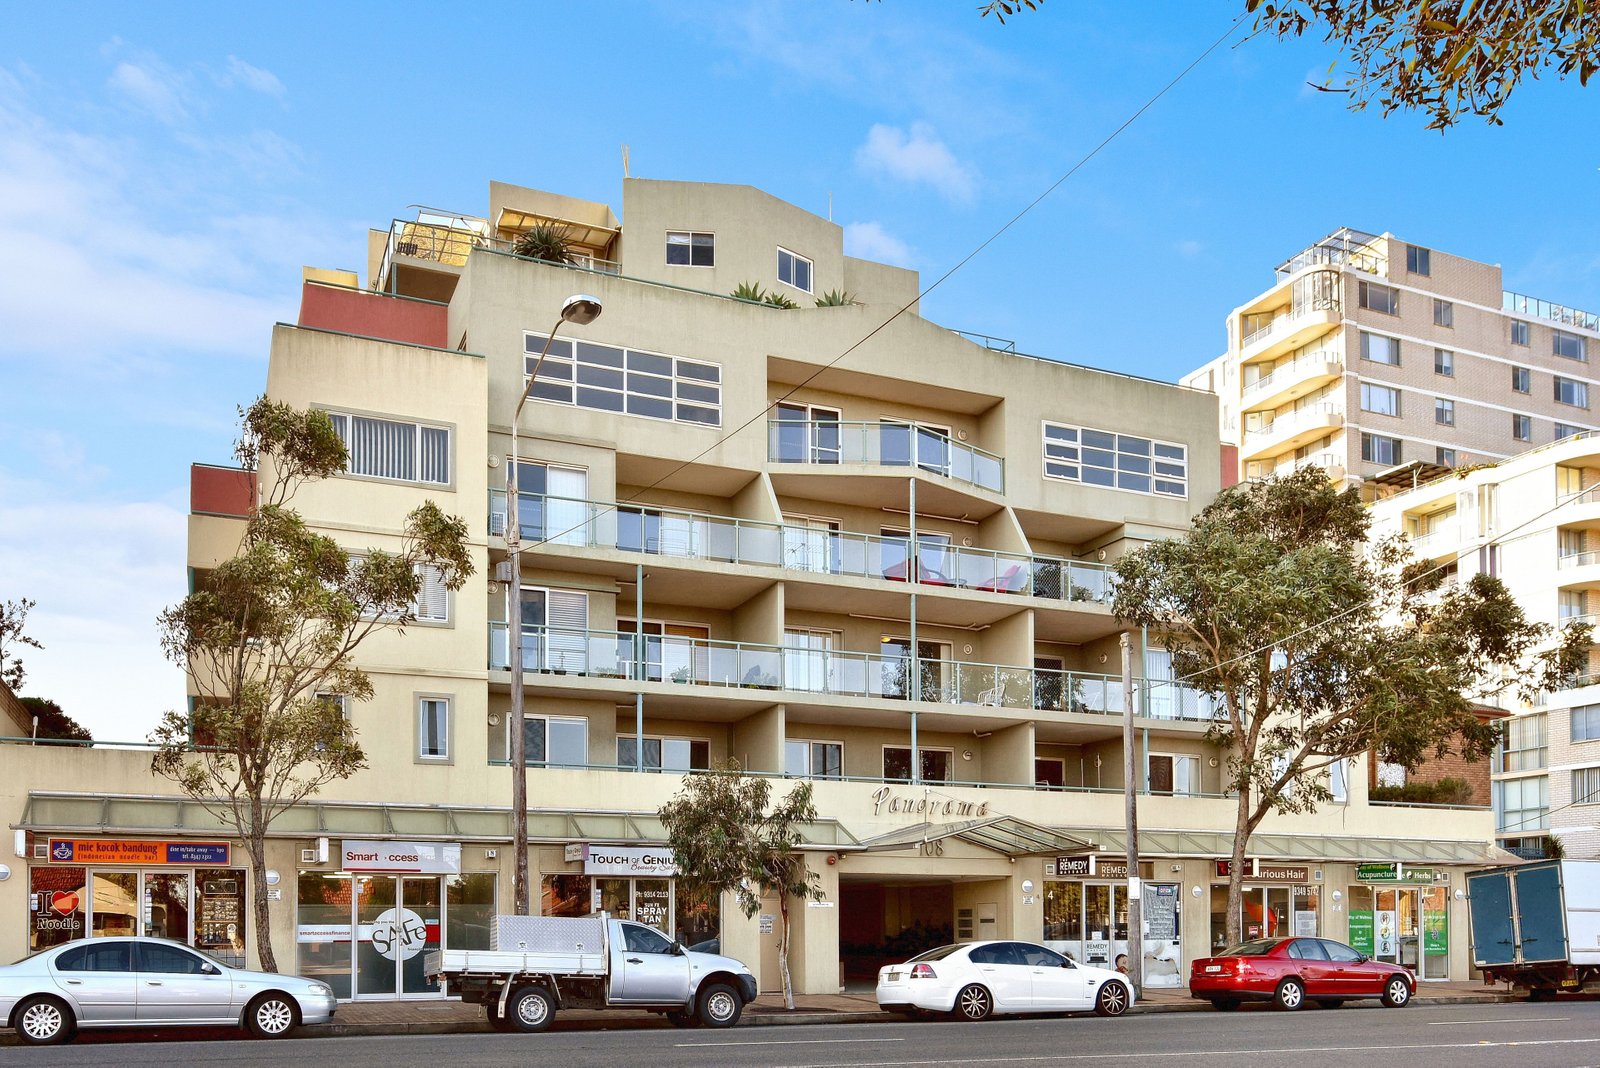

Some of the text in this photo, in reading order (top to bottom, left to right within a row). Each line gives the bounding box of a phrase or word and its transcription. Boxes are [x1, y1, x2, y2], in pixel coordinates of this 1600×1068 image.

[872, 786, 989, 817] Panorama
[96, 843, 120, 852] kocok
[122, 843, 158, 854] bandung
[919, 839, 944, 857] 108
[346, 851, 379, 862] Smart
[384, 853, 419, 862] ccess
[642, 854, 677, 865] GENIU
[630, 863, 658, 873] Beauty
[1059, 860, 1088, 871] REMEDY
[1101, 866, 1128, 875] REMED
[1255, 869, 1305, 879] urious Hair
[1358, 871, 1397, 880] Acupuncture
[1414, 871, 1431, 879] Herbs
[643, 890, 656, 898] 9314
[1047, 890, 1054, 900] 4
[37, 891, 52, 916] I
[637, 907, 667, 915] SPRAY
[37, 918, 80, 929] Noodle
[643, 915, 662, 923] TAN
